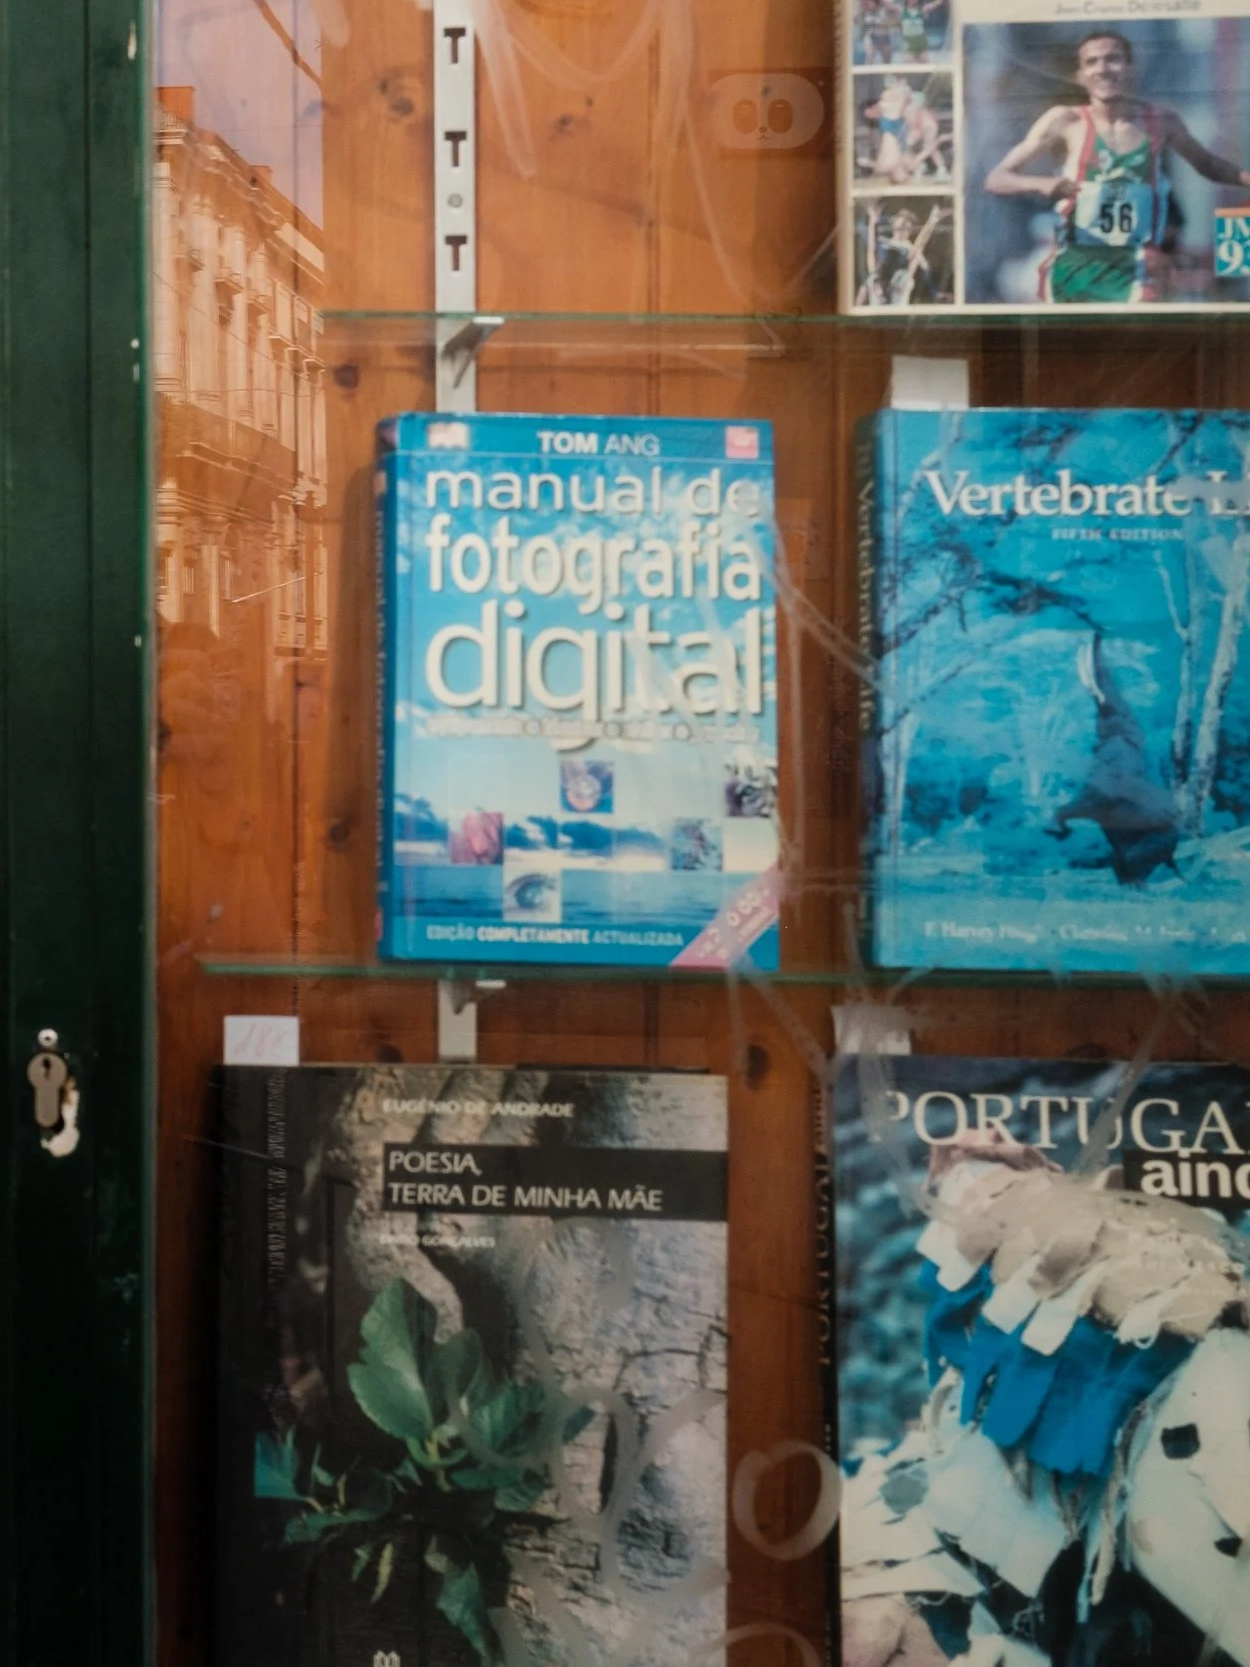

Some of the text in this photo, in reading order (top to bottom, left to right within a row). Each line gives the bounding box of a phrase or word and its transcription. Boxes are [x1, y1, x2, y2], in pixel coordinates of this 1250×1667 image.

[1100, 203, 1133, 233] 56
[537, 431, 660, 457] TOM ANG
[425, 466, 760, 519] manual de
[923, 468, 1192, 516] Vertebrate
[425, 514, 762, 616] fotografia
[425, 599, 764, 754] digital
[426, 922, 684, 947] EDIÇÃO COMPLETAMENTE ACTUALIZADA
[490, 1102, 575, 1119] ANDRADE
[885, 1090, 1250, 1156] PORTUGA
[388, 1150, 482, 1177] POESIA,
[388, 1182, 665, 1212] TERRA DE MINHA MÃE
